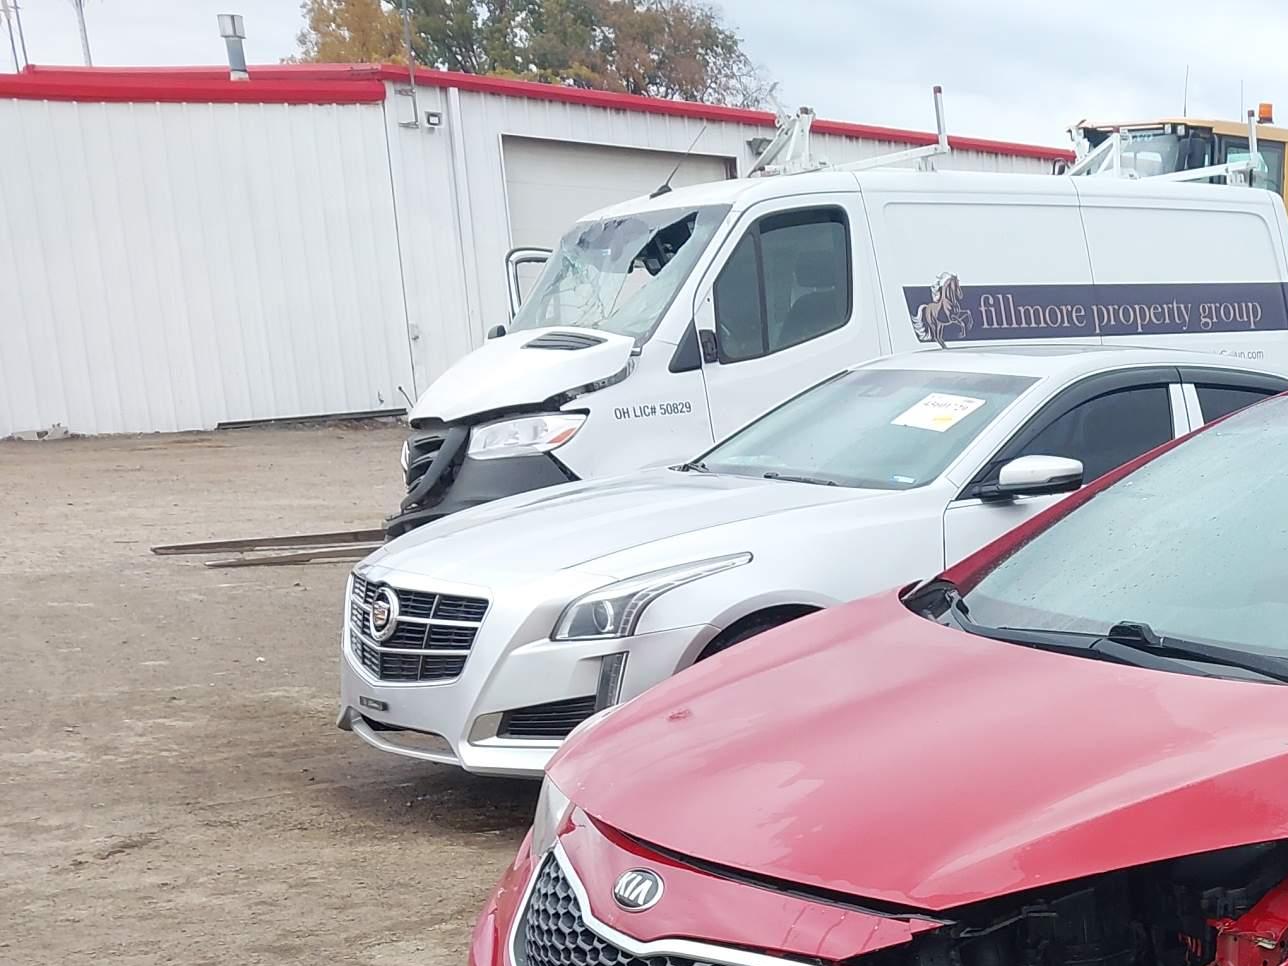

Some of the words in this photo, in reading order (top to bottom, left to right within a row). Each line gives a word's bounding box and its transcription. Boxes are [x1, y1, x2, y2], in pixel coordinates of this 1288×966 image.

[979, 294, 1087, 328] fillmore
[1091, 298, 1192, 332] property
[1199, 302, 1262, 330] group
[614, 407, 631, 420] OH
[633, 404, 657, 418] LIC#
[659, 401, 692, 416] 50829
